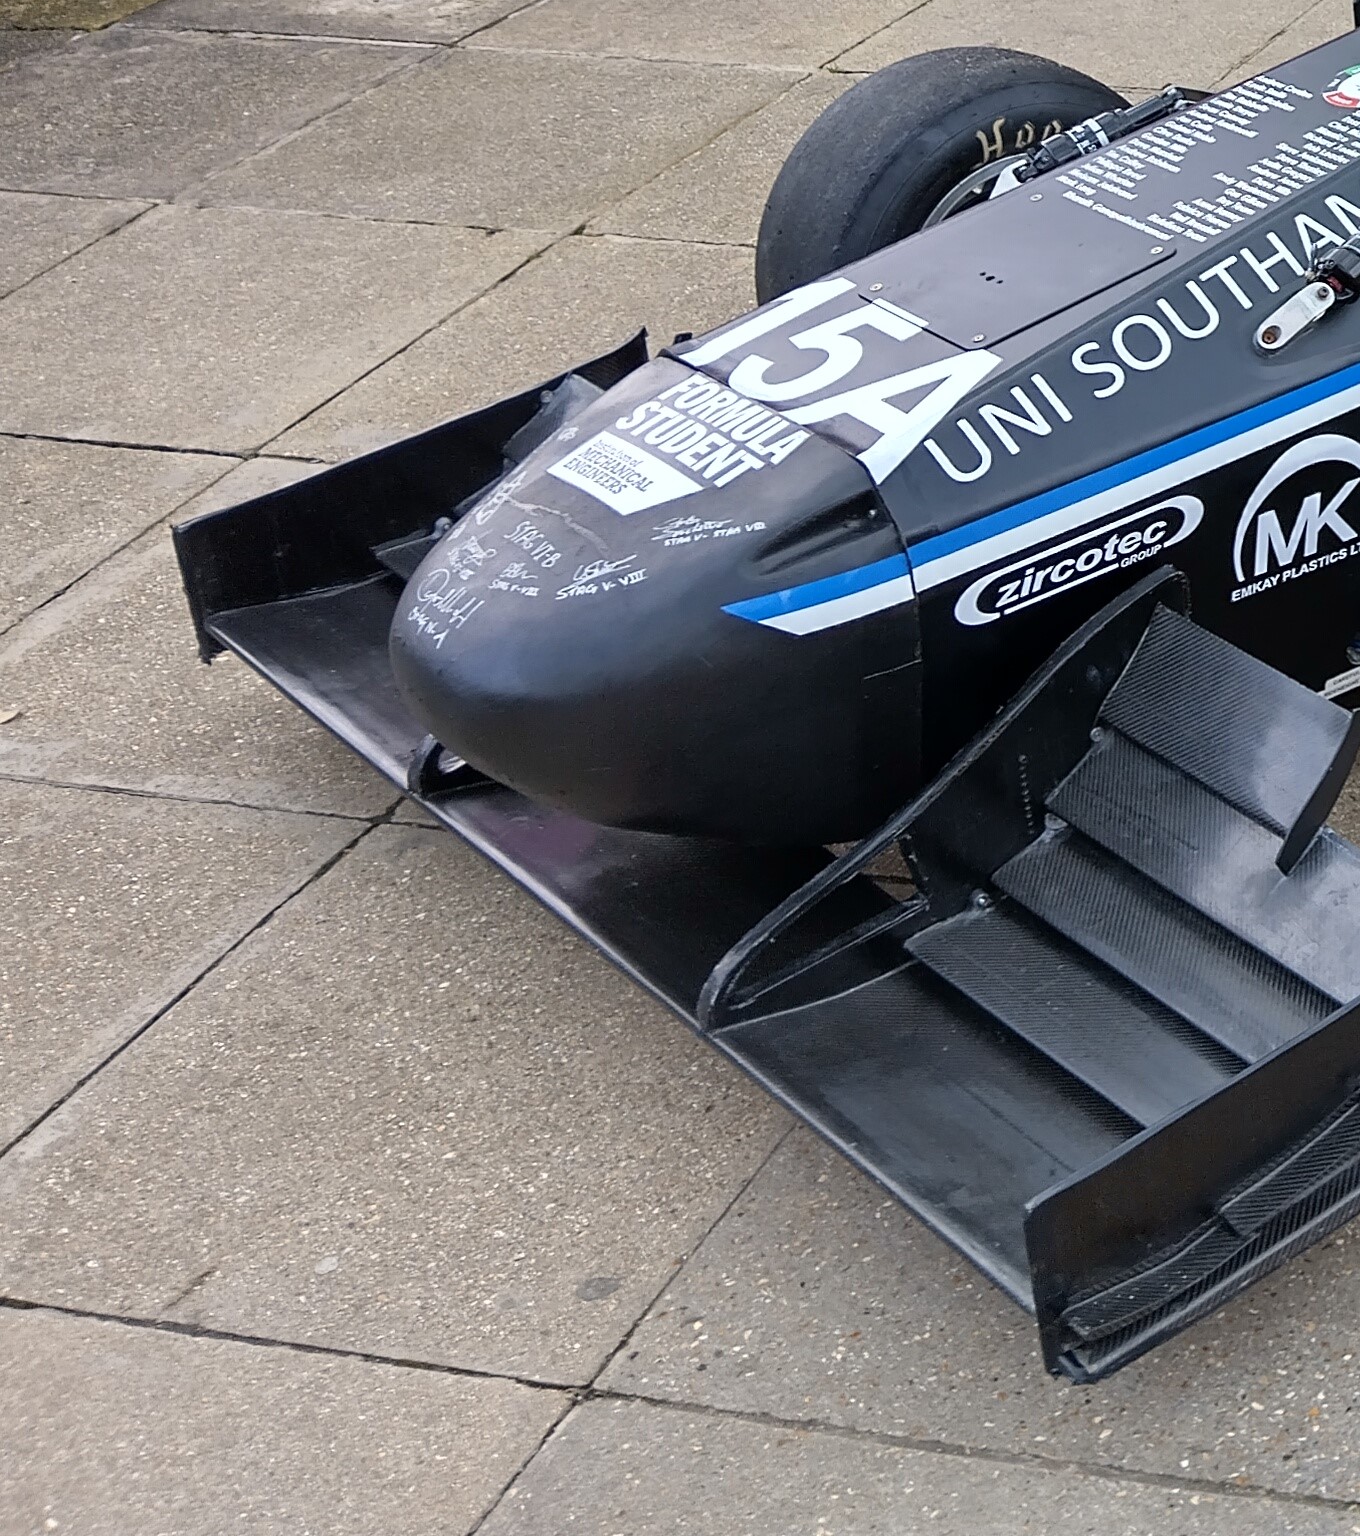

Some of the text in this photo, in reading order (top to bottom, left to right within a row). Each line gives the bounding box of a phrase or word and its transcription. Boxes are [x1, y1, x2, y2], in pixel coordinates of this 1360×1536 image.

[657, 370, 815, 466] FORMULA
[679, 276, 1003, 485] 15A
[578, 447, 654, 493] MECHANICAL
[614, 401, 766, 488] STUDENT
[923, 371, 1073, 484] UNI
[563, 457, 628, 495] ENGINEERS
[996, 515, 1168, 611] zircotec
[1119, 543, 1163, 569] GROUP
[1230, 573, 1281, 603] EMKAY
[1281, 548, 1348, 584] PLASTICS
